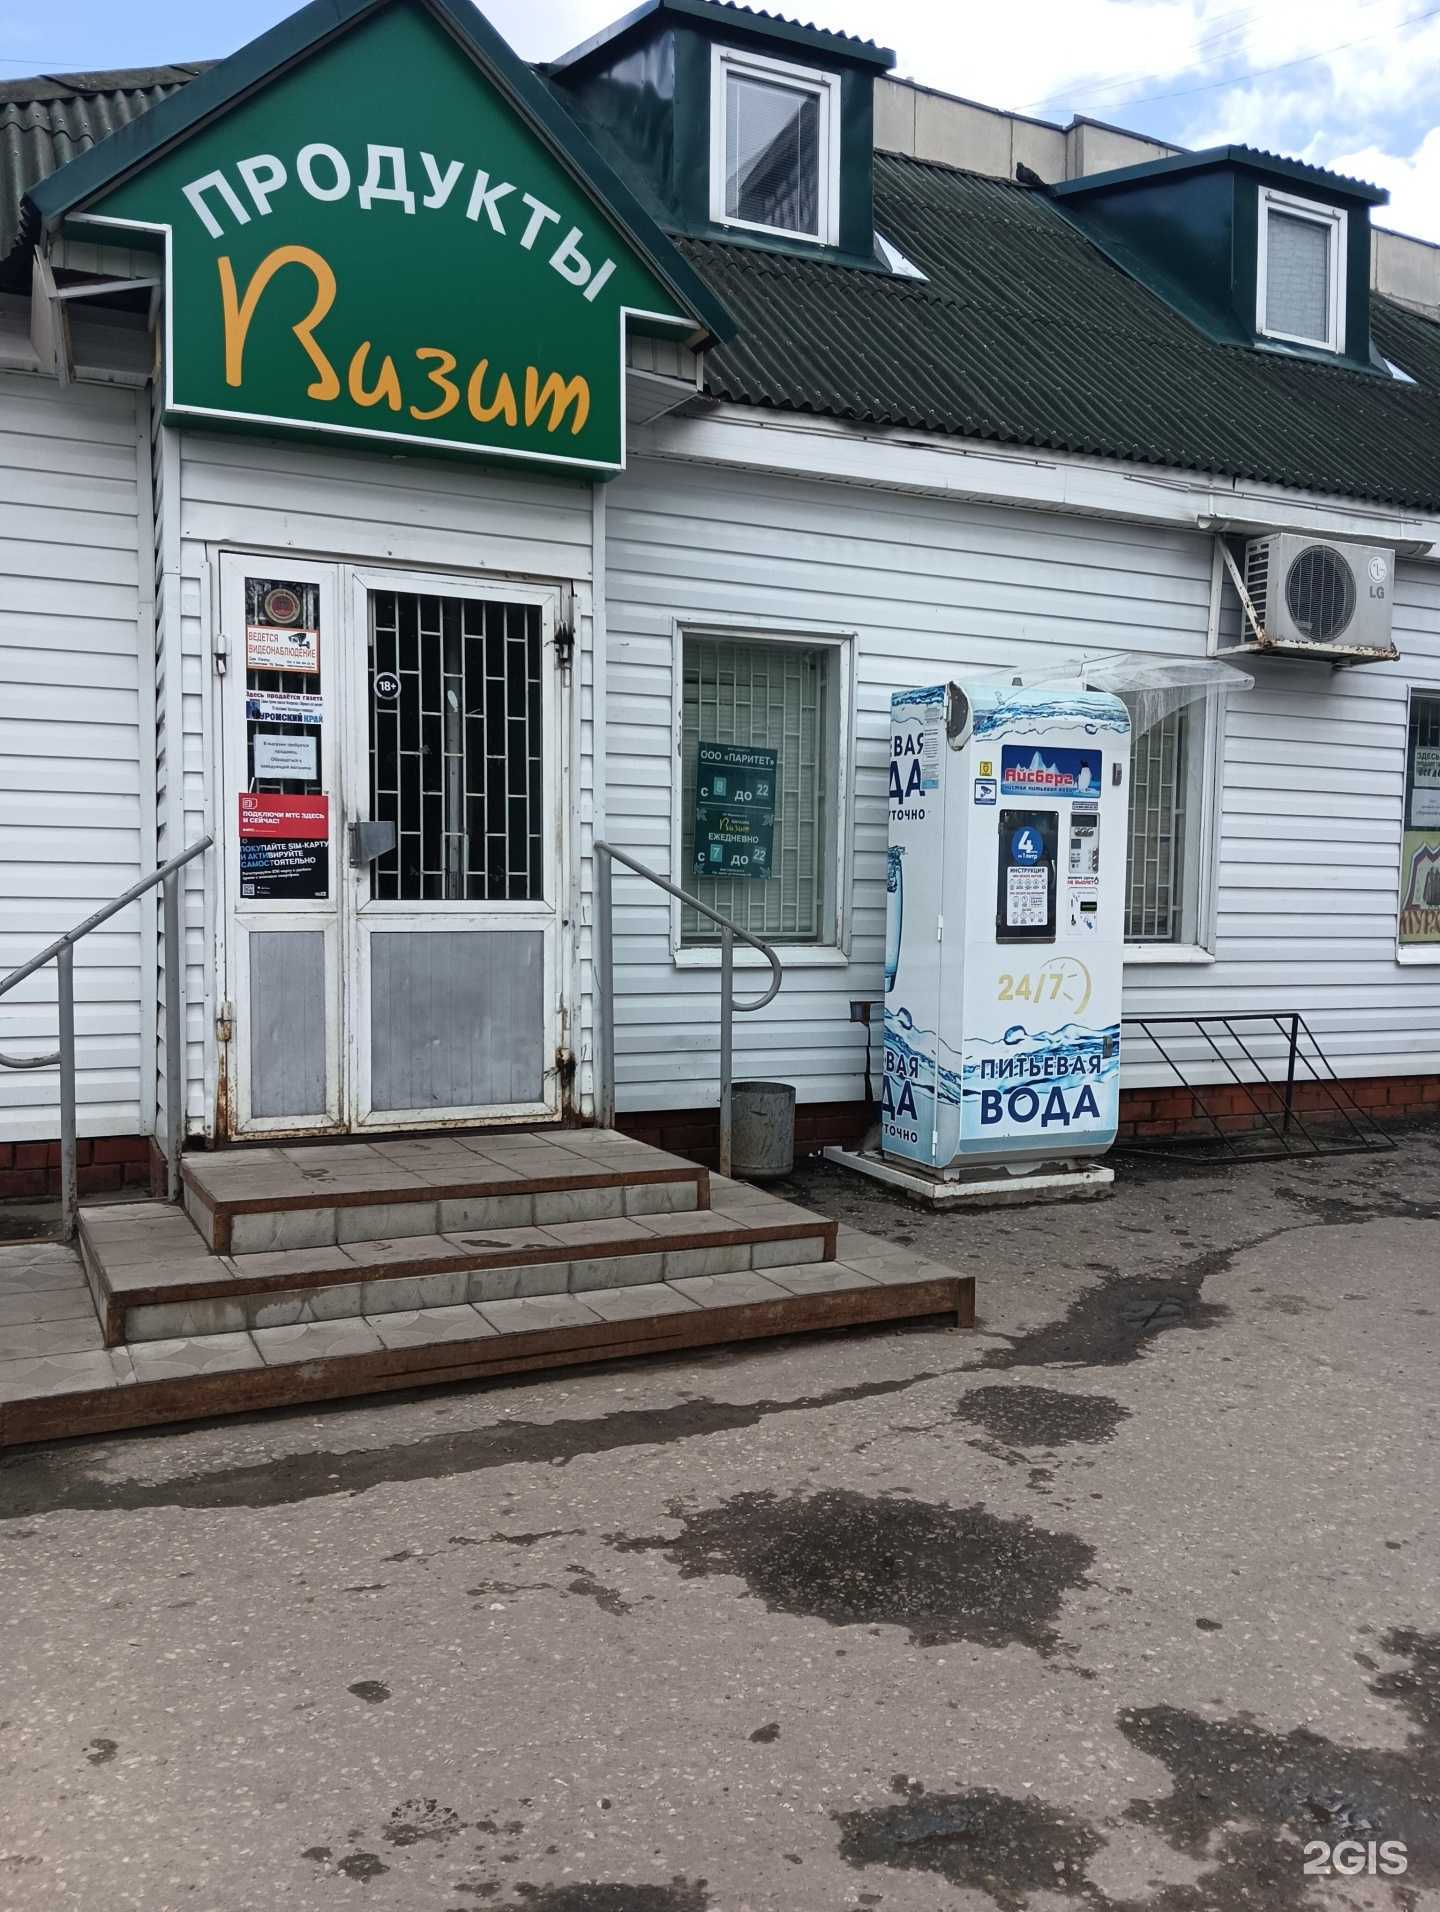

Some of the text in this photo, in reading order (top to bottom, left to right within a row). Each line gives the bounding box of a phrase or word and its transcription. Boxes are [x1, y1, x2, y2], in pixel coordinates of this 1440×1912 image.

[181, 142, 618, 304] ПРОДУКТЫ
[217, 244, 592, 437] Визит
[1370, 586, 1384, 600] LG
[248, 631, 279, 643] ВЕДЕТСЯ
[248, 644, 316, 658] ВИДЕОНАБЛЮДЕНИЕ
[378, 680, 397, 692] 18+
[890, 732, 924, 757] ВАЯ
[700, 750, 775, 766] ООО «ПАРИТЕТ»
[1004, 767, 1074, 787] Айсберг
[243, 810, 284, 818] ПОДКЛЮЧИ
[240, 840, 329, 852] ПОКУПАЙТЕ SIM-КАРТУ
[708, 832, 759, 844] ЕЖЕДНЕВНО
[1017, 830, 1034, 852] 4
[241, 856, 317, 868] САМОСТОЯТЕЛЬНО
[247, 849, 304, 860] АКТИВИРУЙТЕ
[997, 973, 1064, 1004] 24/7
[884, 1051, 919, 1079] ВАЯ
[980, 1054, 1102, 1080] ПИТЬЕВАЯ
[980, 1084, 1101, 1128] ВОДА
[883, 1122, 919, 1144] ТОЧНО
